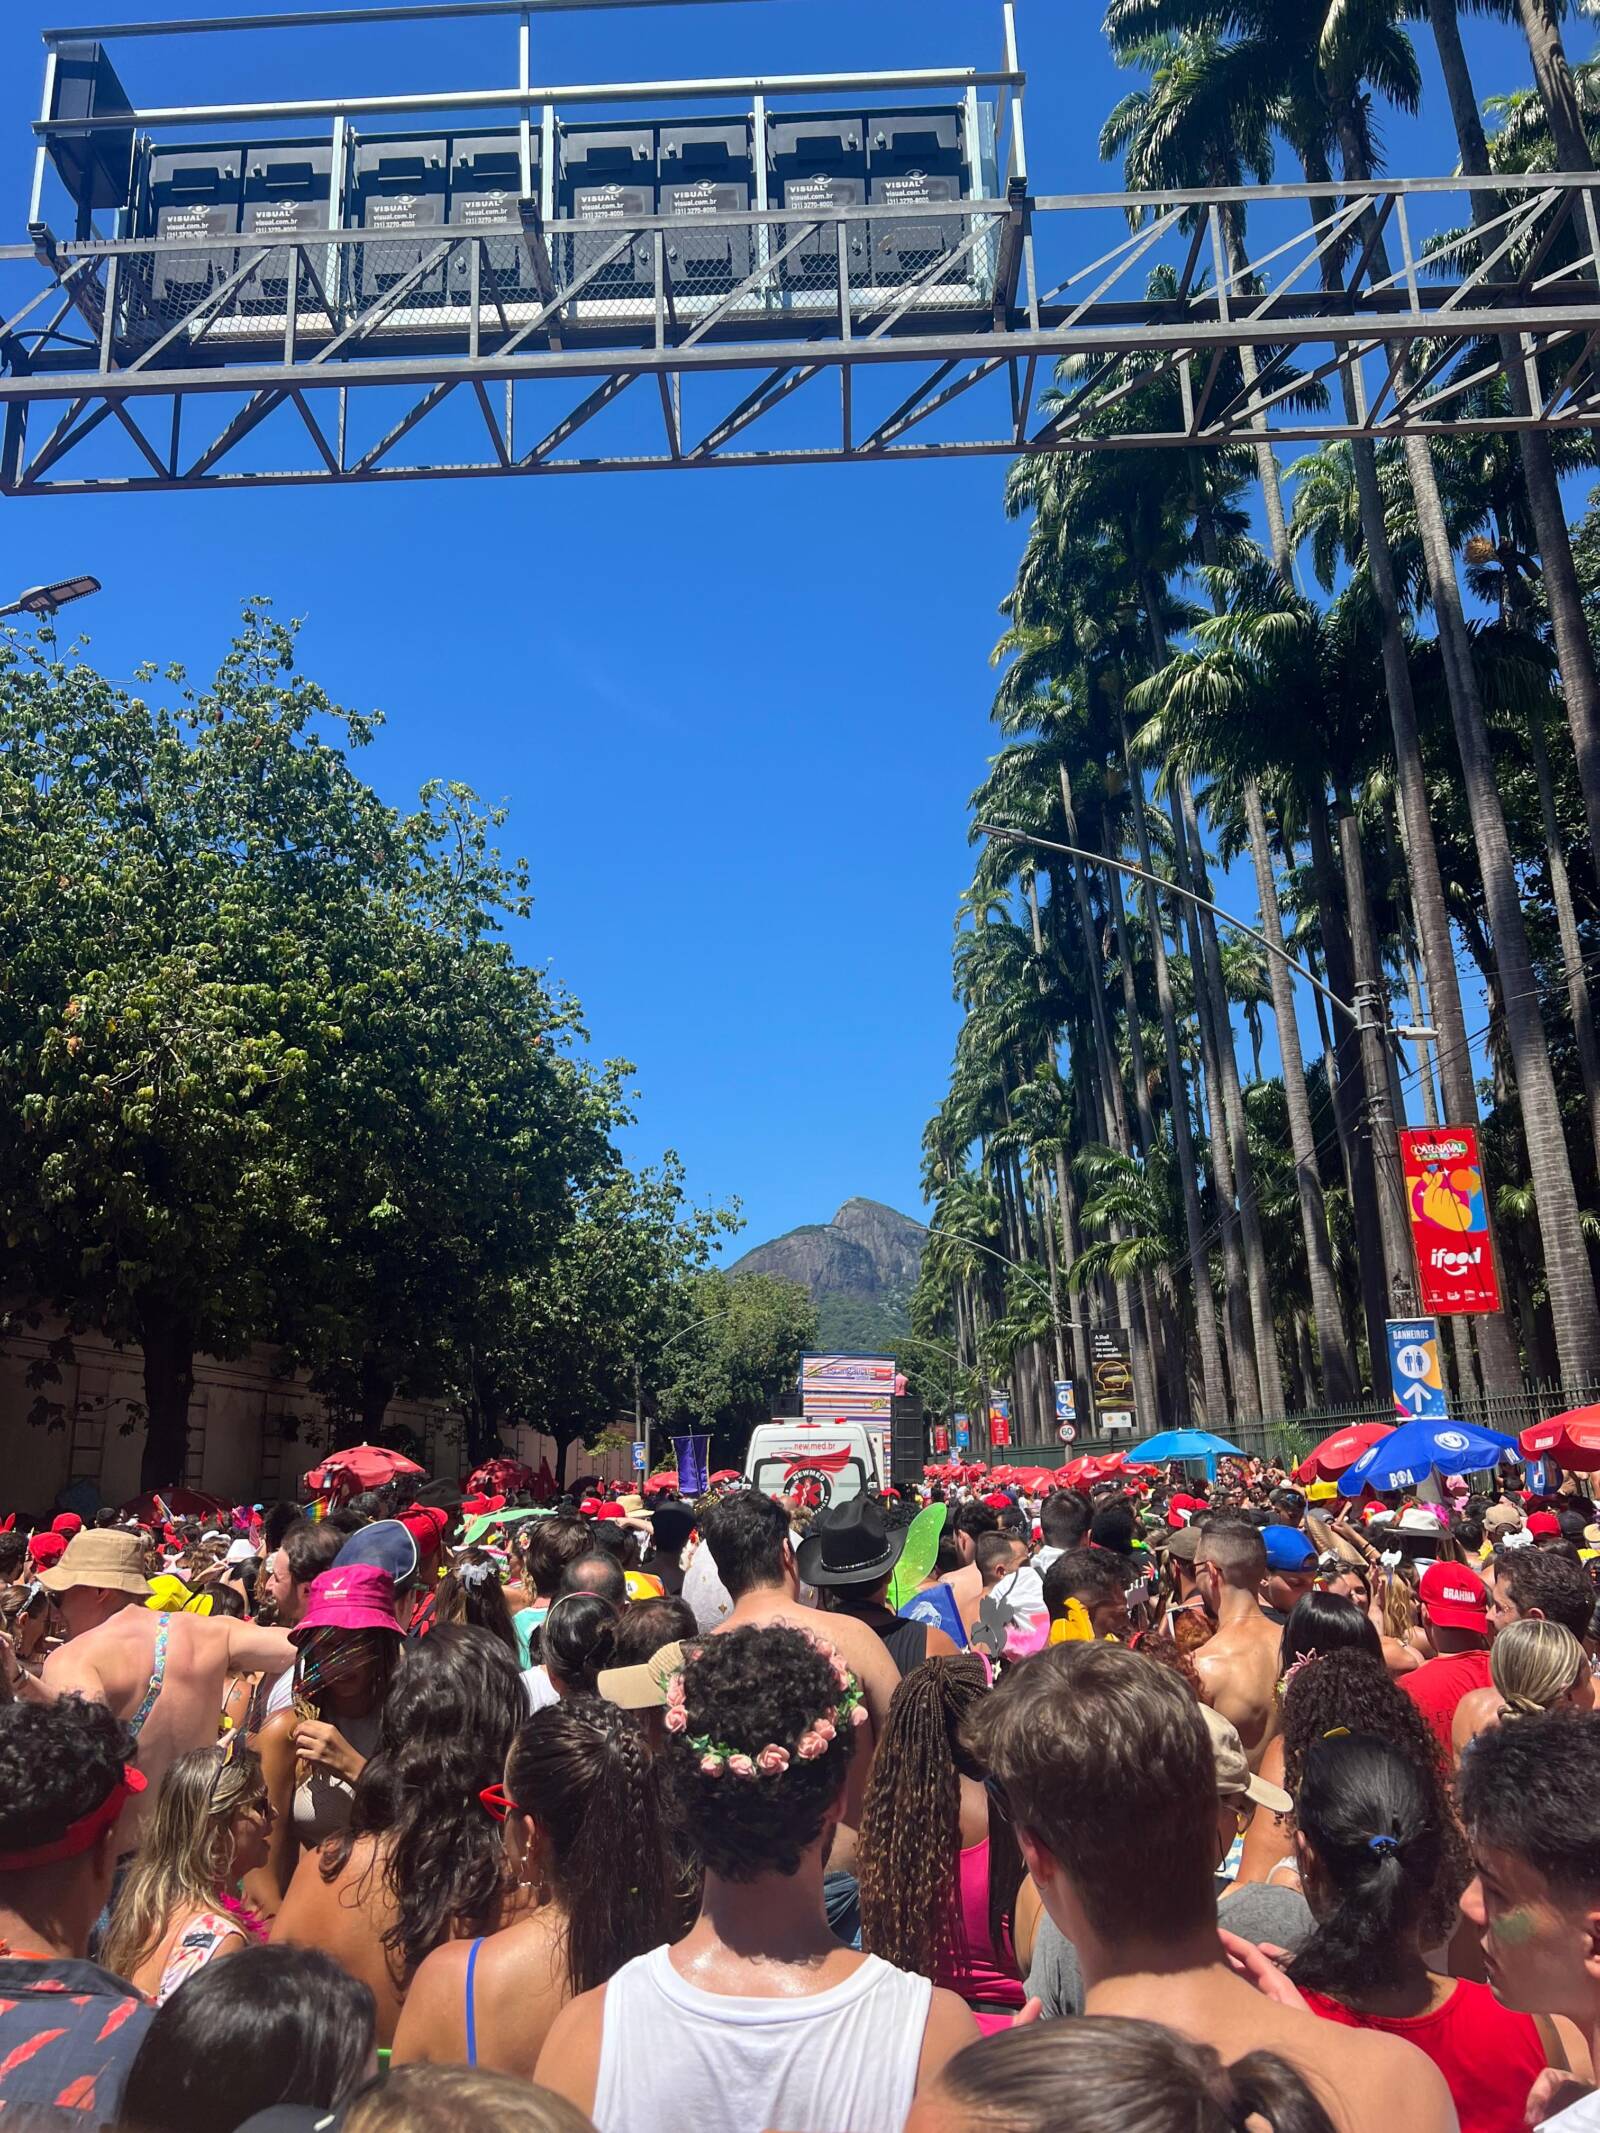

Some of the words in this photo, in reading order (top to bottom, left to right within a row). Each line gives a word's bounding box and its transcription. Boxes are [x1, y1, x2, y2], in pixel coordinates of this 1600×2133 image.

[1415, 1143, 1466, 1154] CARNAVAL
[1393, 1329, 1429, 1340] BANHEIROS
[1062, 1428, 1073, 1436] 60
[792, 1469, 826, 1482] NEWMED
[1443, 1587, 1476, 1602] BRAHMA
